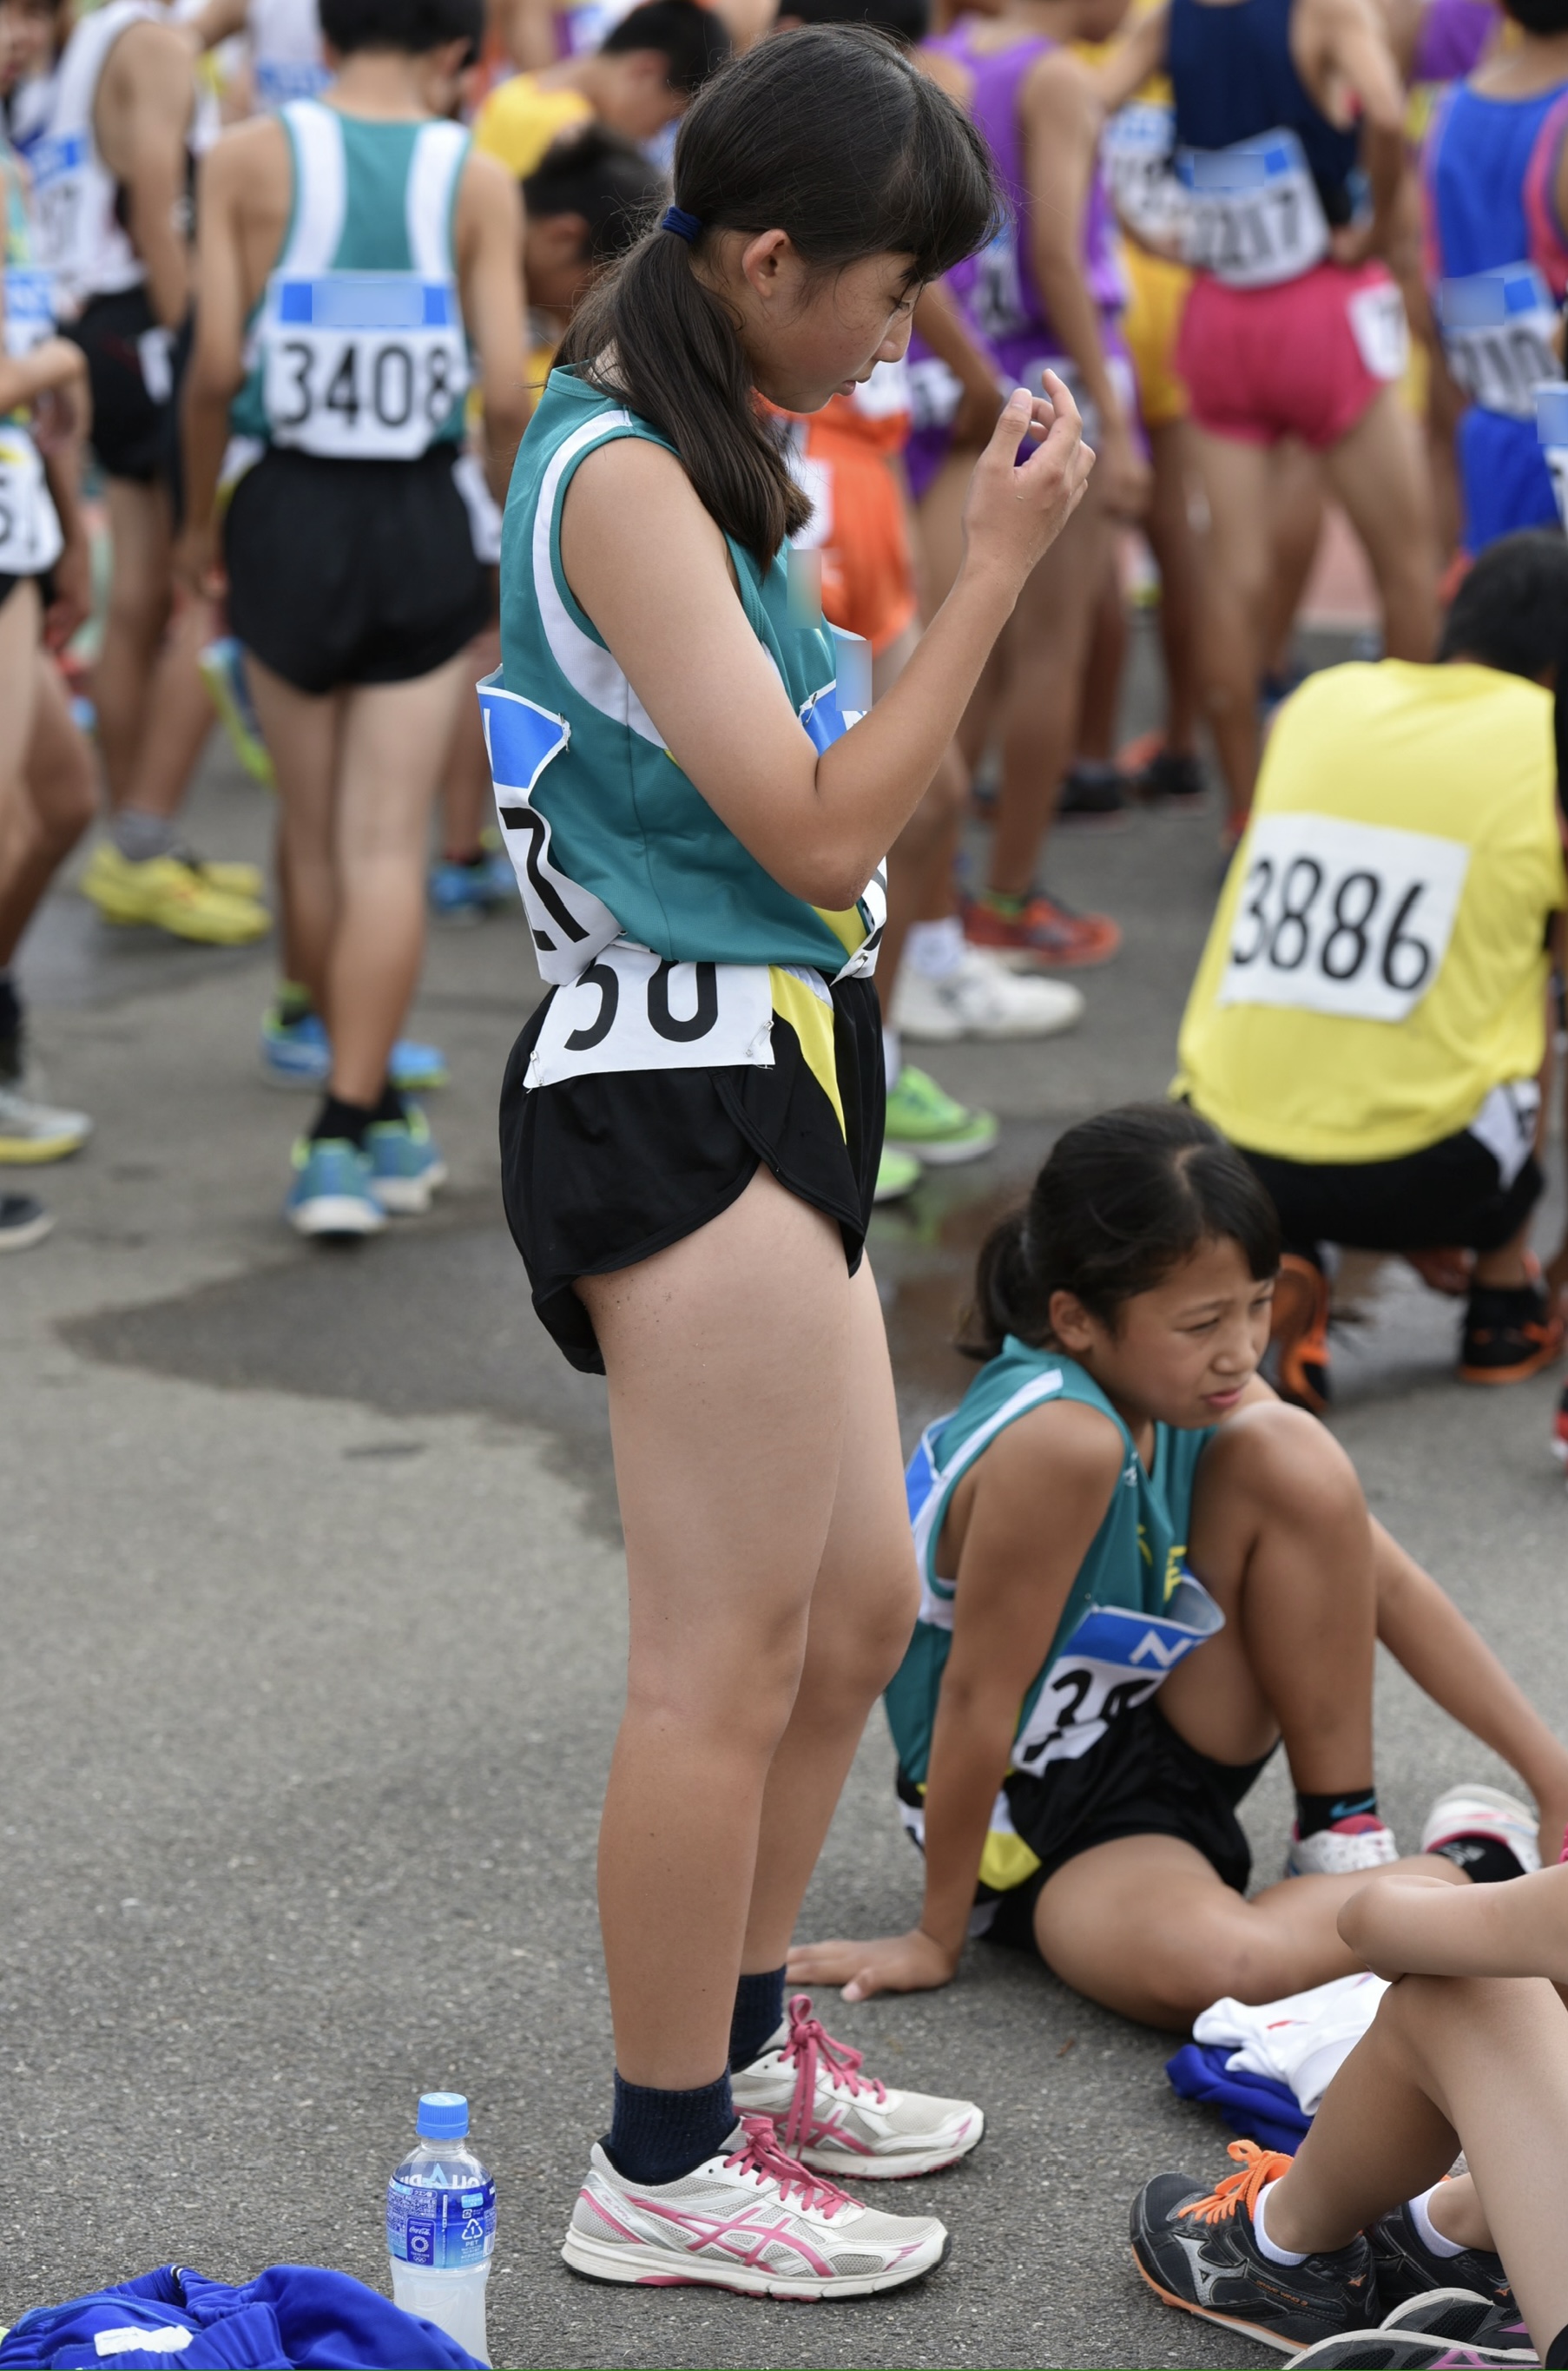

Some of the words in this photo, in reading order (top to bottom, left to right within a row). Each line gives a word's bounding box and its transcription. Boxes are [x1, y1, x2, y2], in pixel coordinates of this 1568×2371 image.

[283, 341, 452, 426] 3408
[499, 807, 590, 952] 7
[1231, 853, 1433, 992] 3886
